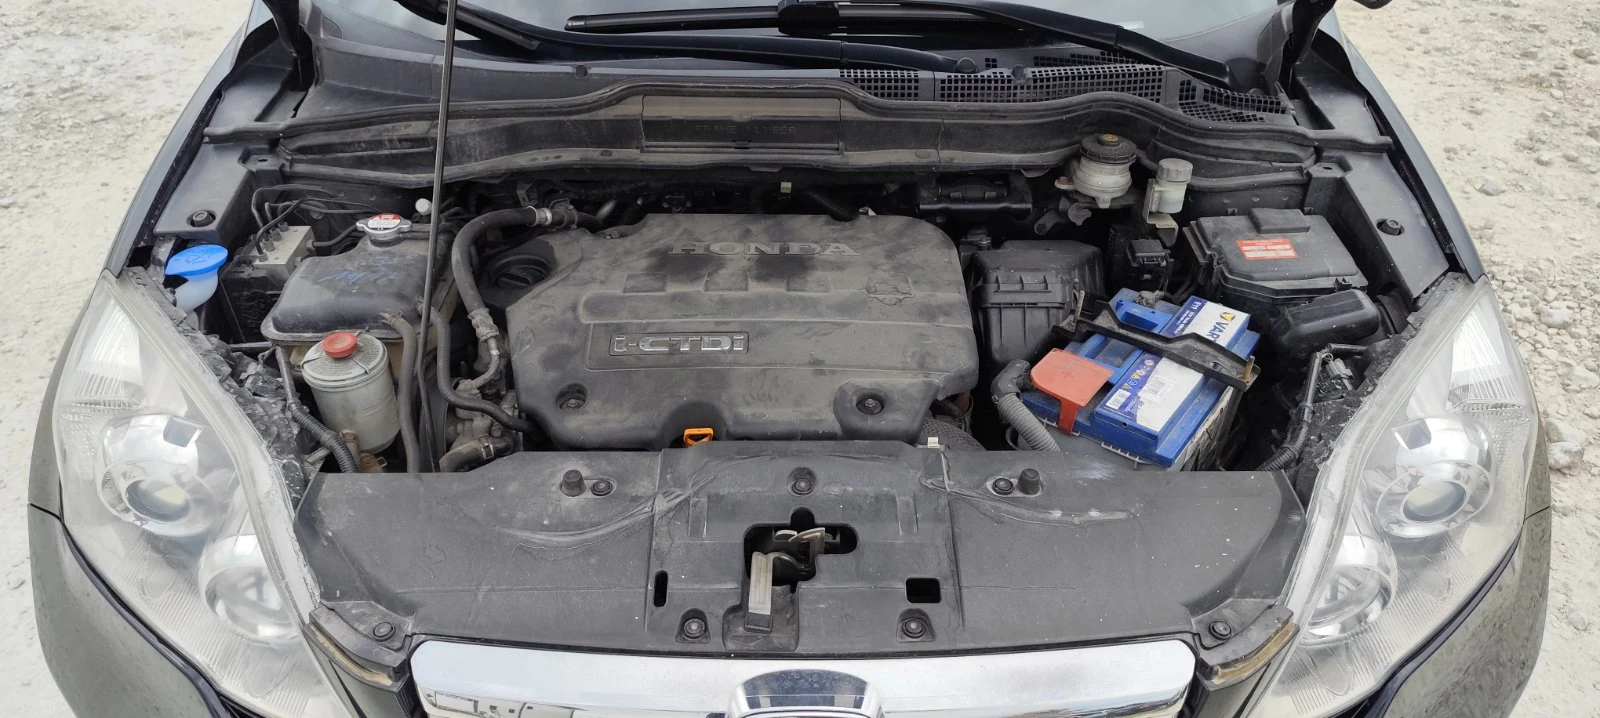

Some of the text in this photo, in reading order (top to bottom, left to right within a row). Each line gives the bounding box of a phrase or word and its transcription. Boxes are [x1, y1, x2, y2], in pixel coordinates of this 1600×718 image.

[695, 125, 799, 135] FRAME NUMBER
[666, 241, 862, 256] HONDA
[1206, 321, 1229, 342] VAR
[614, 335, 744, 352] i-CTDi
